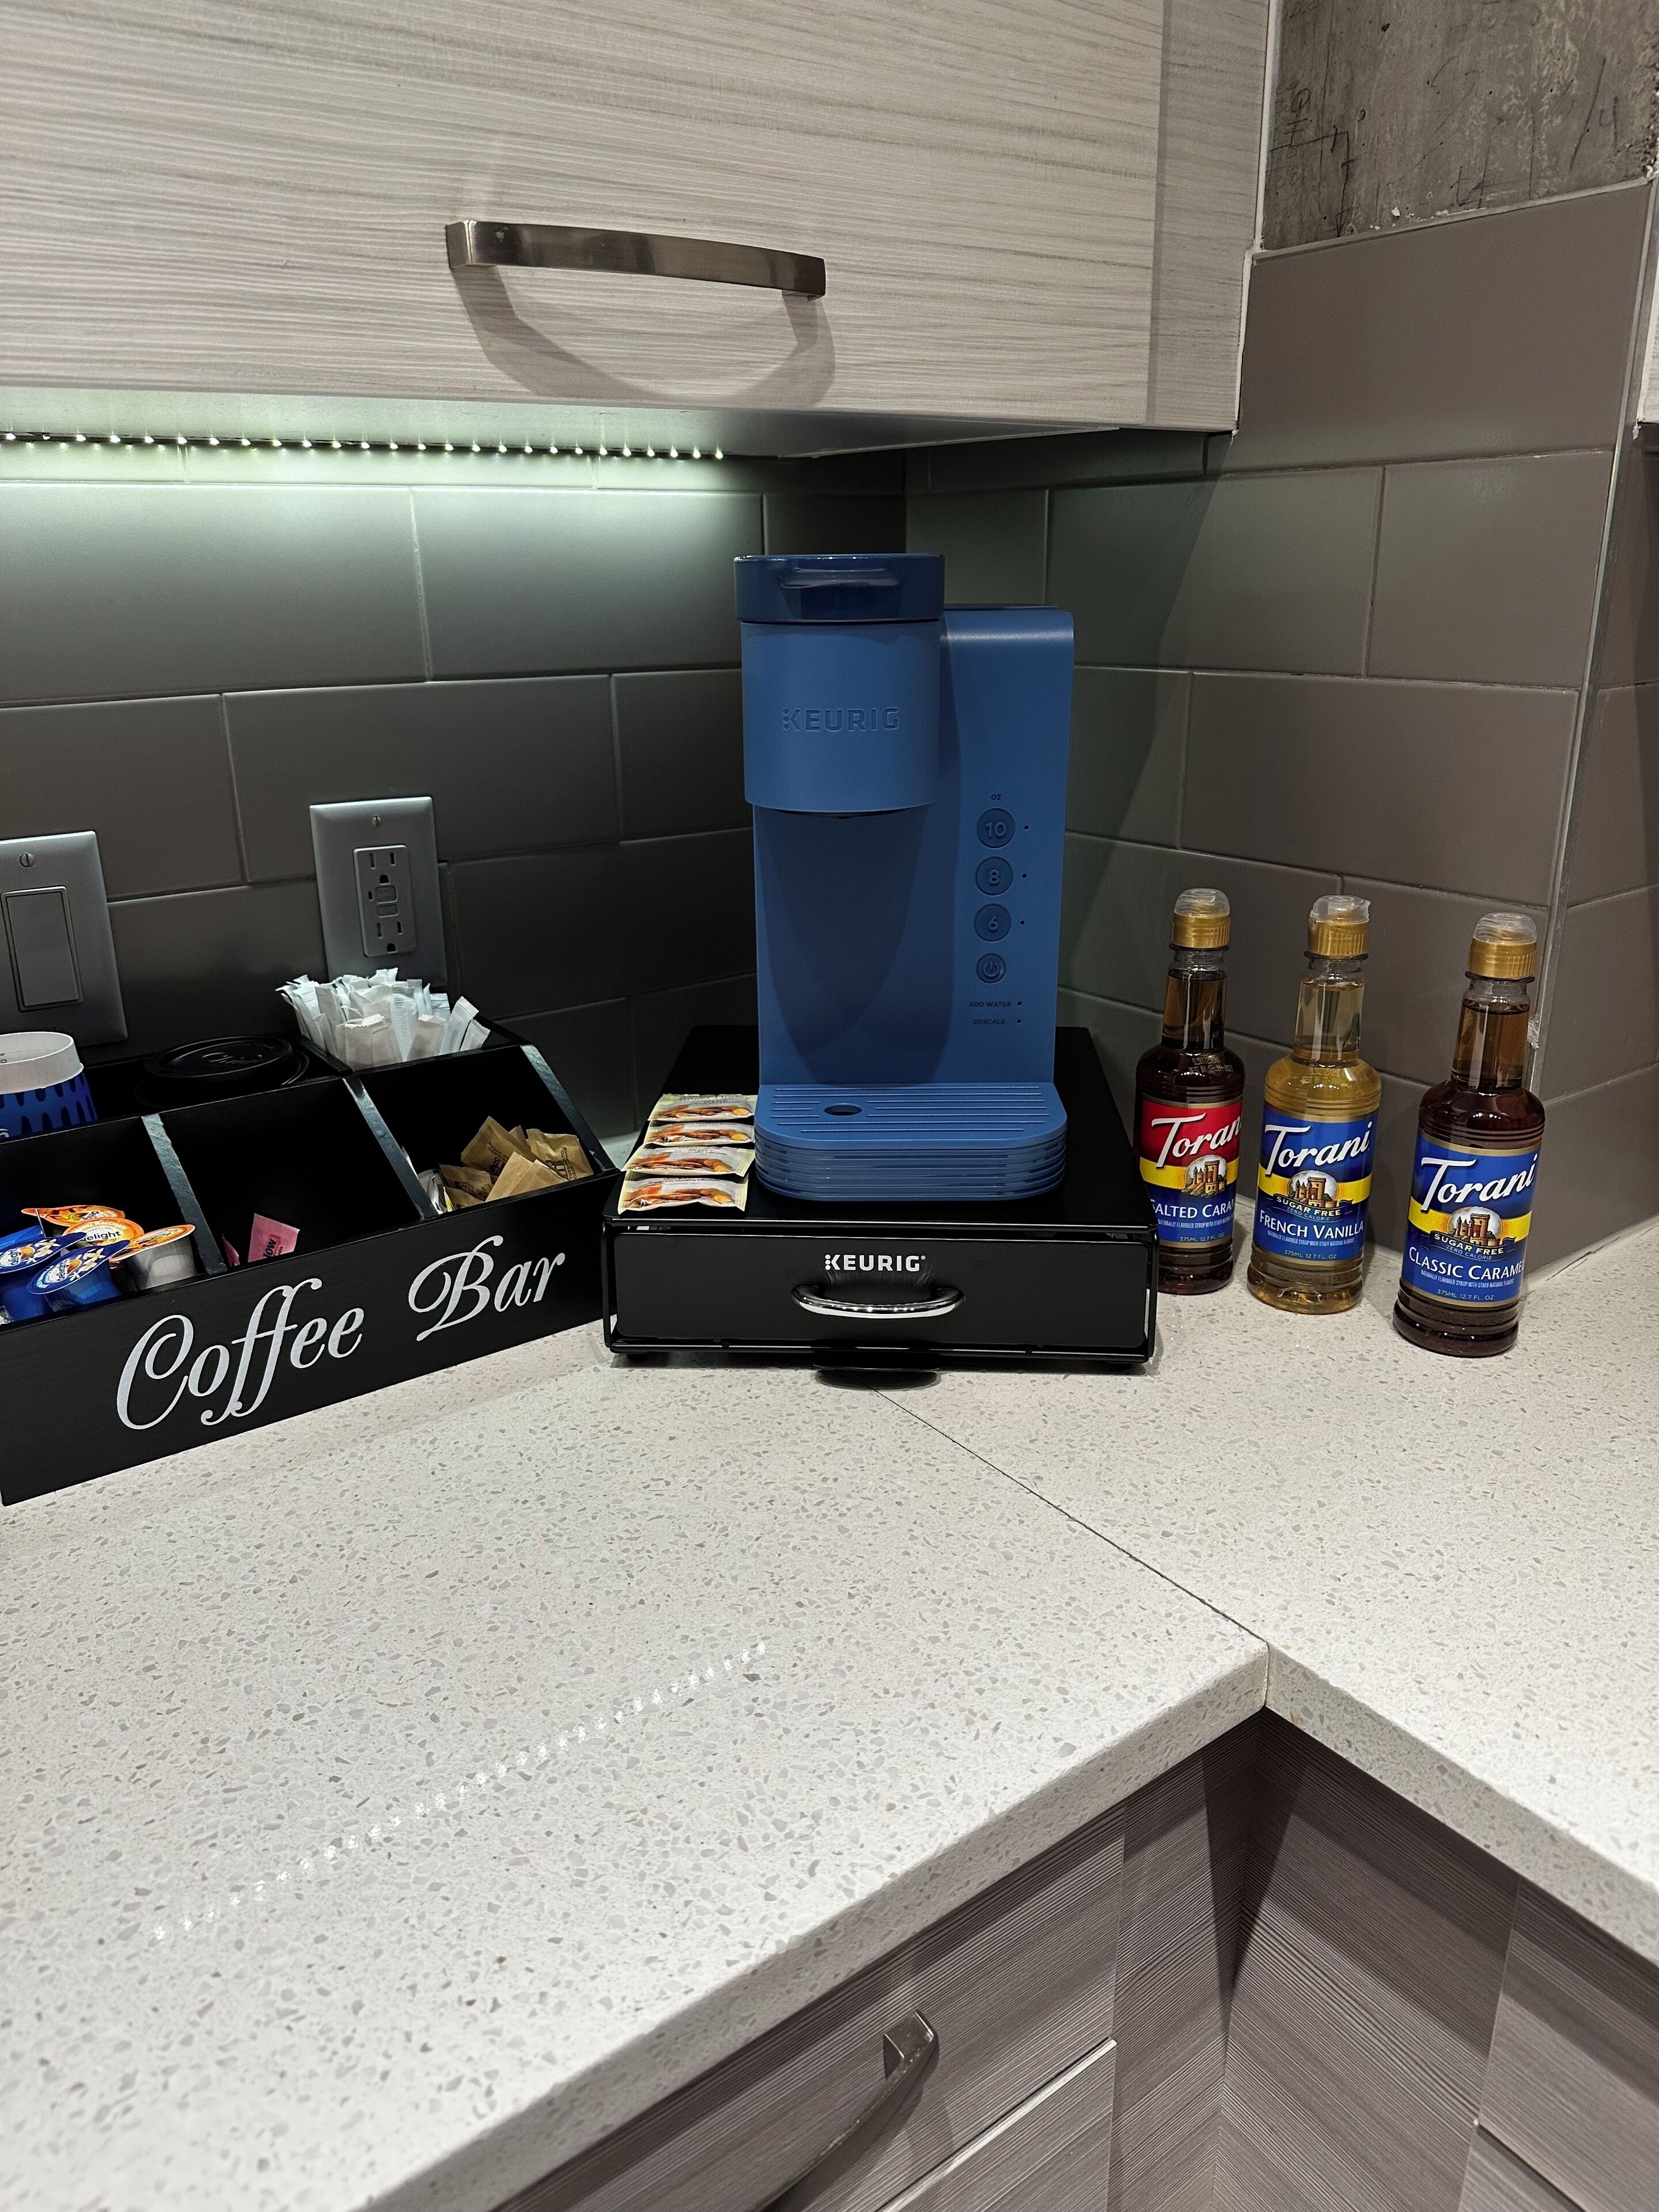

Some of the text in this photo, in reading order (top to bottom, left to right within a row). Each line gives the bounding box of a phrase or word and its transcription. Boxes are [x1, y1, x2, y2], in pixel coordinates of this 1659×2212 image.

[782, 707, 899, 732] KEURIG
[986, 821, 1007, 837] 10
[988, 869, 1000, 885] 8
[988, 916, 999, 931] 6
[1264, 1121, 1373, 1175] Torani
[1421, 1153, 1538, 1211] Torani
[1276, 1196, 1341, 1217] SUGAR FREE
[1286, 1206, 1330, 1221] ZERO CALORIE
[1259, 1209, 1363, 1239] FRENCH VANILLA
[1434, 1233, 1473, 1252] SUGAR
[1284, 1249, 1304, 1258] 375ML
[1445, 1245, 1493, 1260] ZERO CALORIE
[825, 1254, 920, 1272] KEURIG
[1409, 1247, 1464, 1278] CLASSIC
[1436, 1289, 1457, 1298] 375ML
[116, 1235, 566, 1430] Coffee Bar
